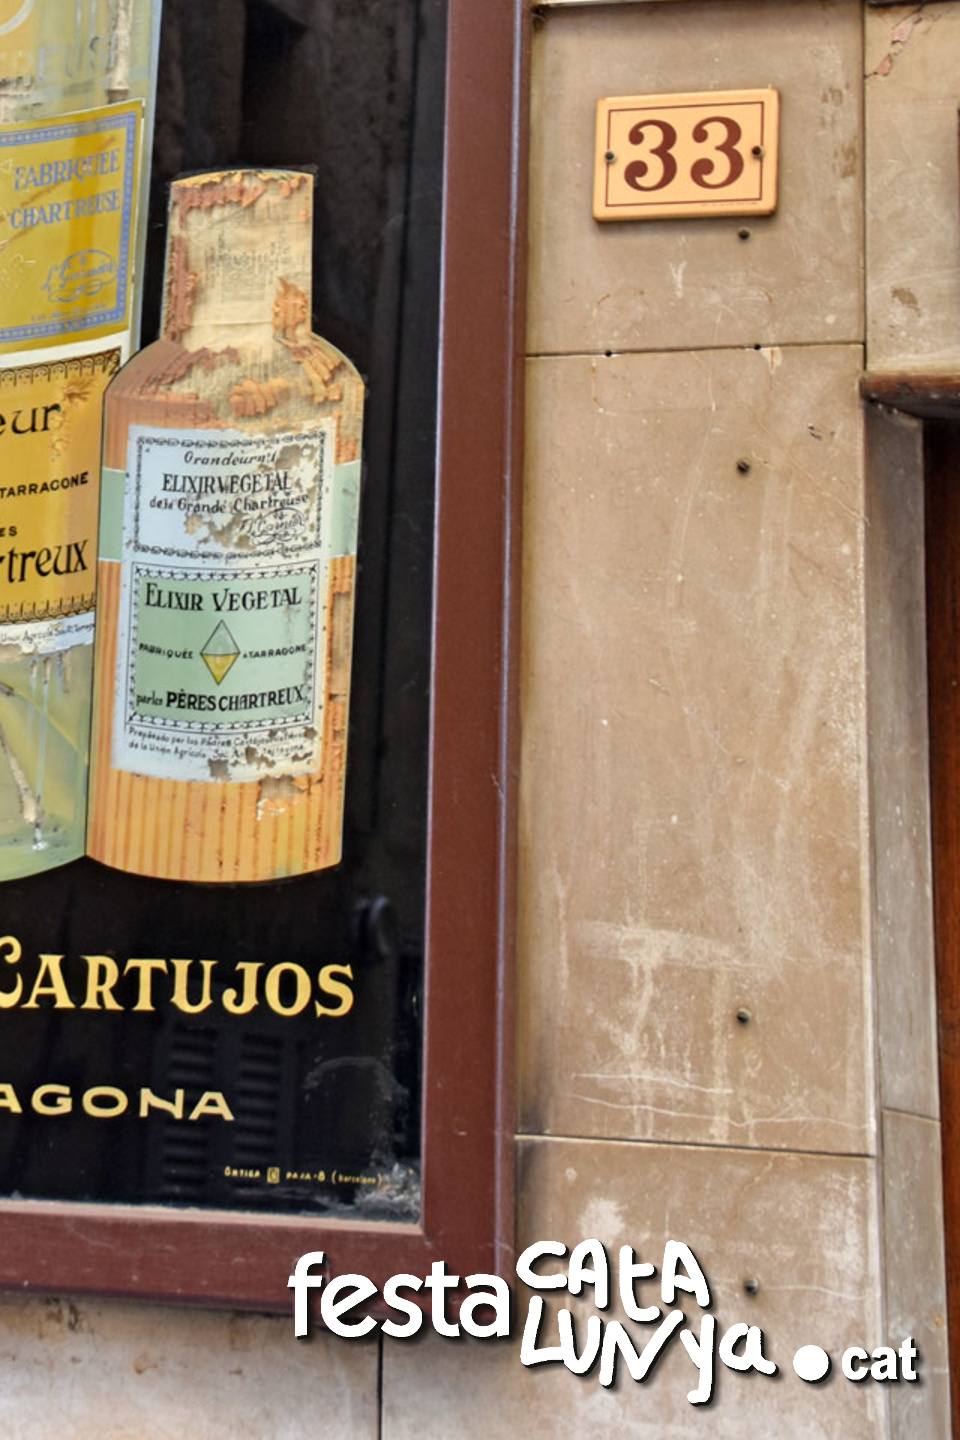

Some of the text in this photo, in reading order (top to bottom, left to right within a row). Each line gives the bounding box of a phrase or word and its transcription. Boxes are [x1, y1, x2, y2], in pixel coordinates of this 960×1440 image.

[624, 116, 744, 192] 33
[10, 189, 121, 229] CHARTREUSE
[144, 582, 303, 612] ELIXIR VEGETAL
